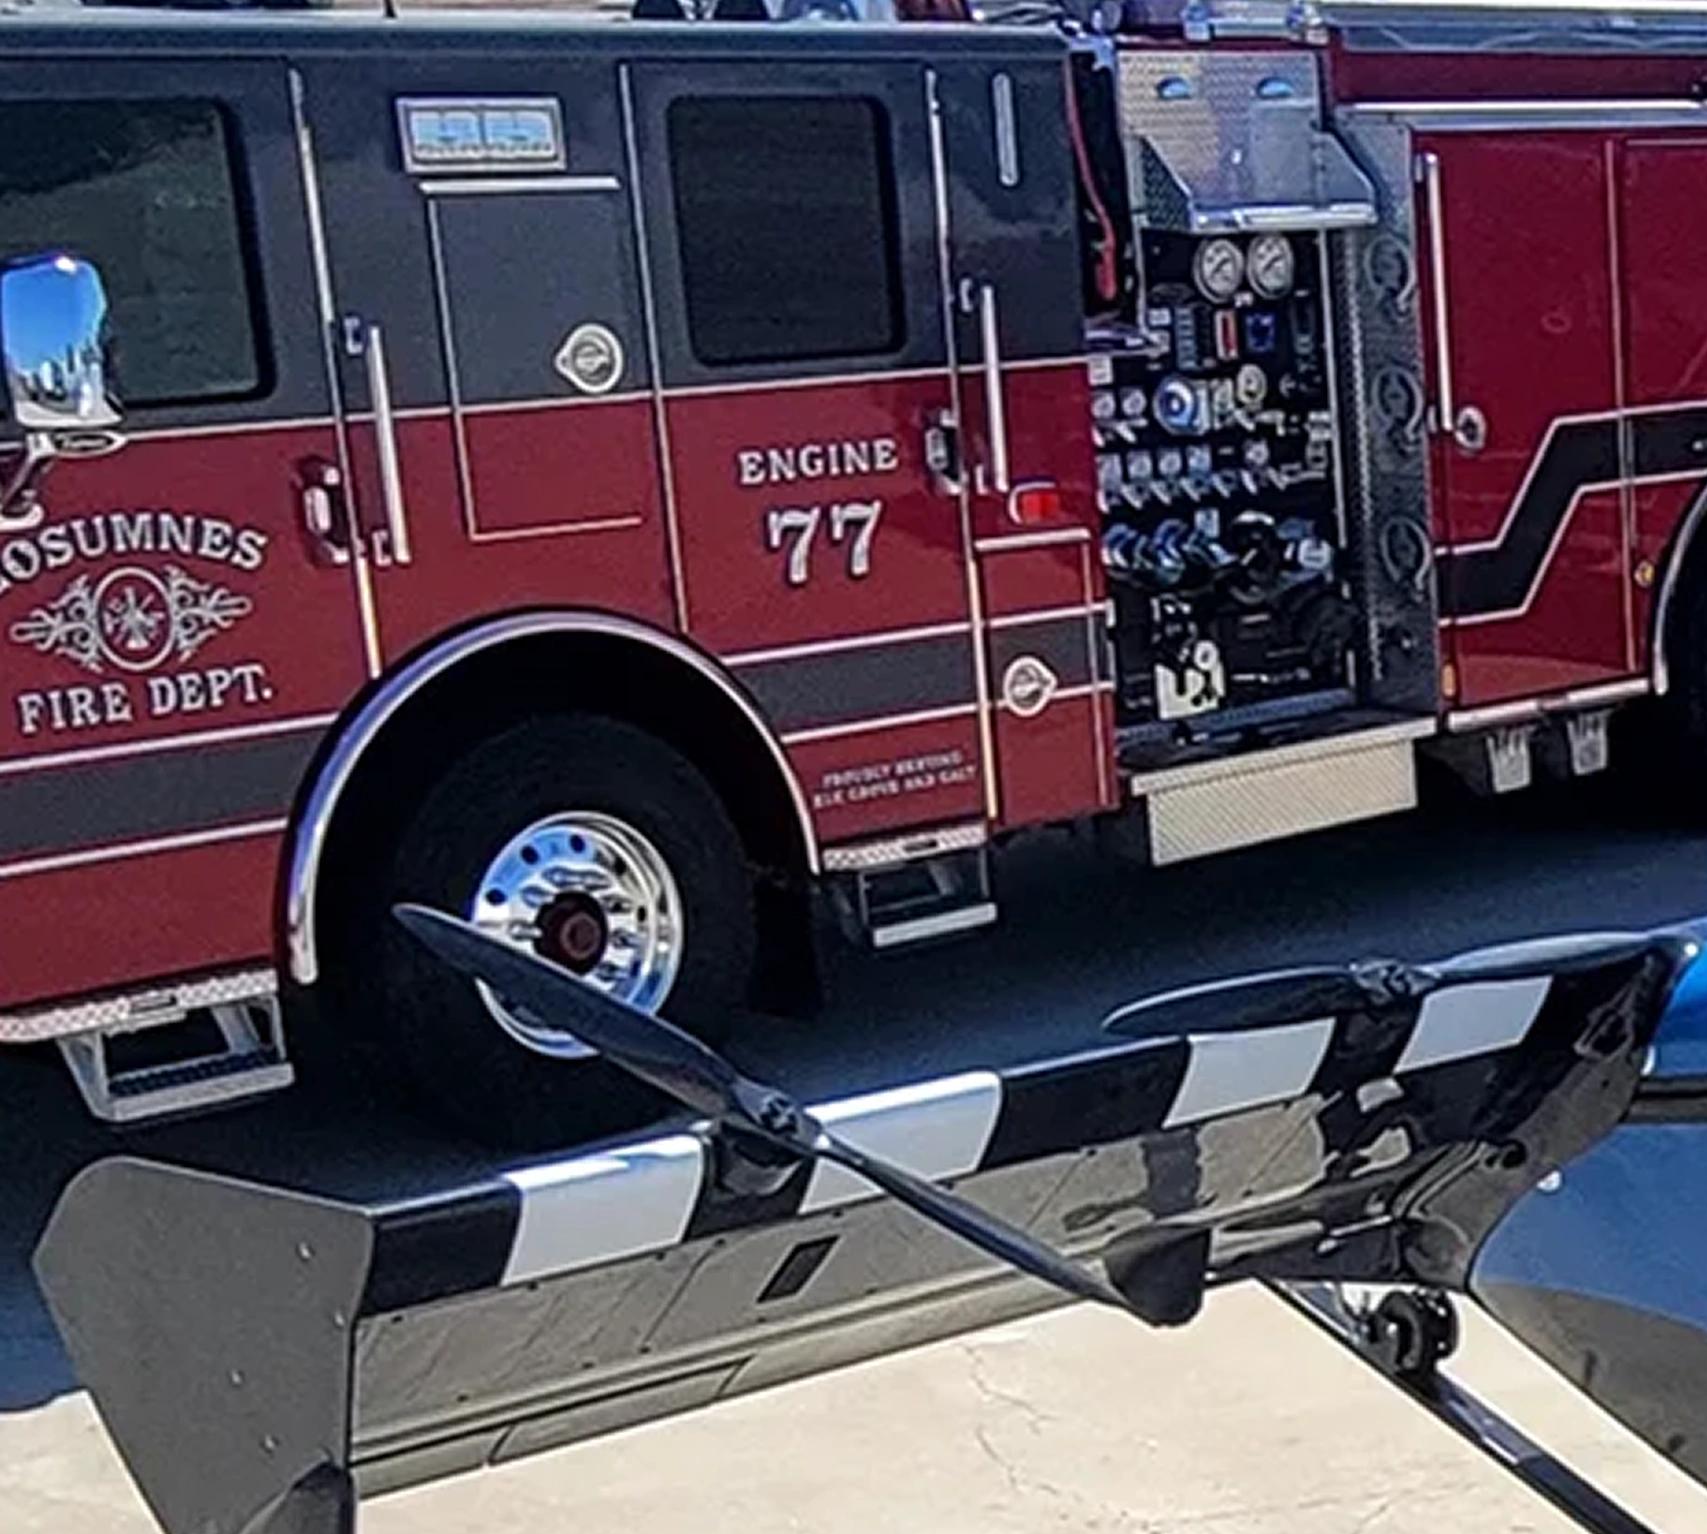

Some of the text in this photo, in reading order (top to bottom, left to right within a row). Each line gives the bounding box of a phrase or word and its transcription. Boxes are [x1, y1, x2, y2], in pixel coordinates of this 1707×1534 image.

[737, 438, 898, 485] ENGINE
[0, 512, 269, 595] OSUMNES
[768, 500, 883, 583] 77
[17, 663, 273, 734] FIRE DEPT.
